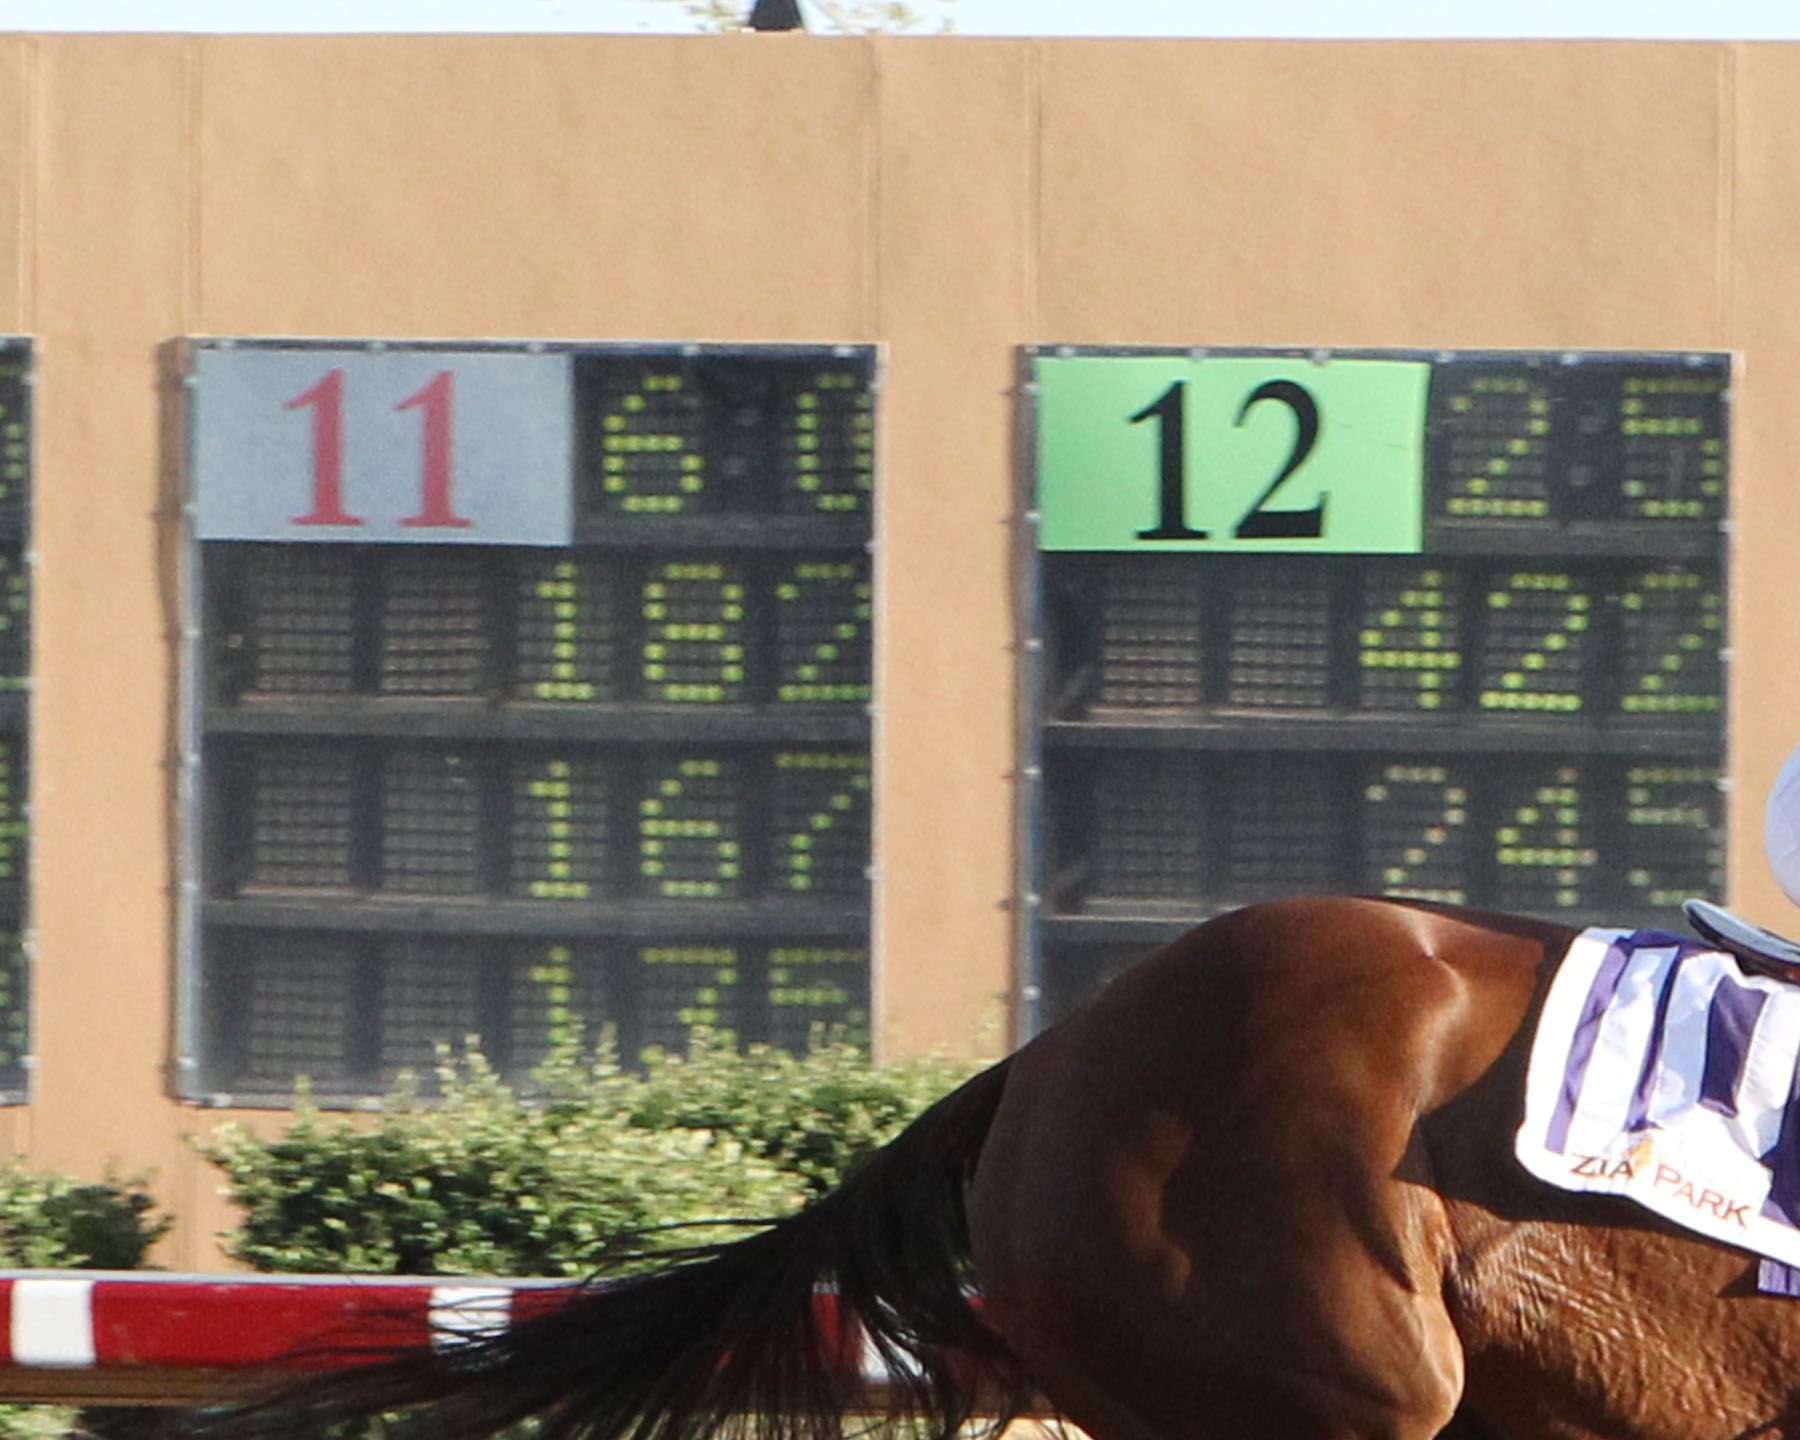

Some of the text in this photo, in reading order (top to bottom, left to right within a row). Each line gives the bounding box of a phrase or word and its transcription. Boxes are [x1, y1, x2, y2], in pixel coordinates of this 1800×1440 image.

[283, 368, 475, 528] 11
[1126, 379, 1331, 540] 12
[1570, 1152, 1753, 1231] ZIA PARK
